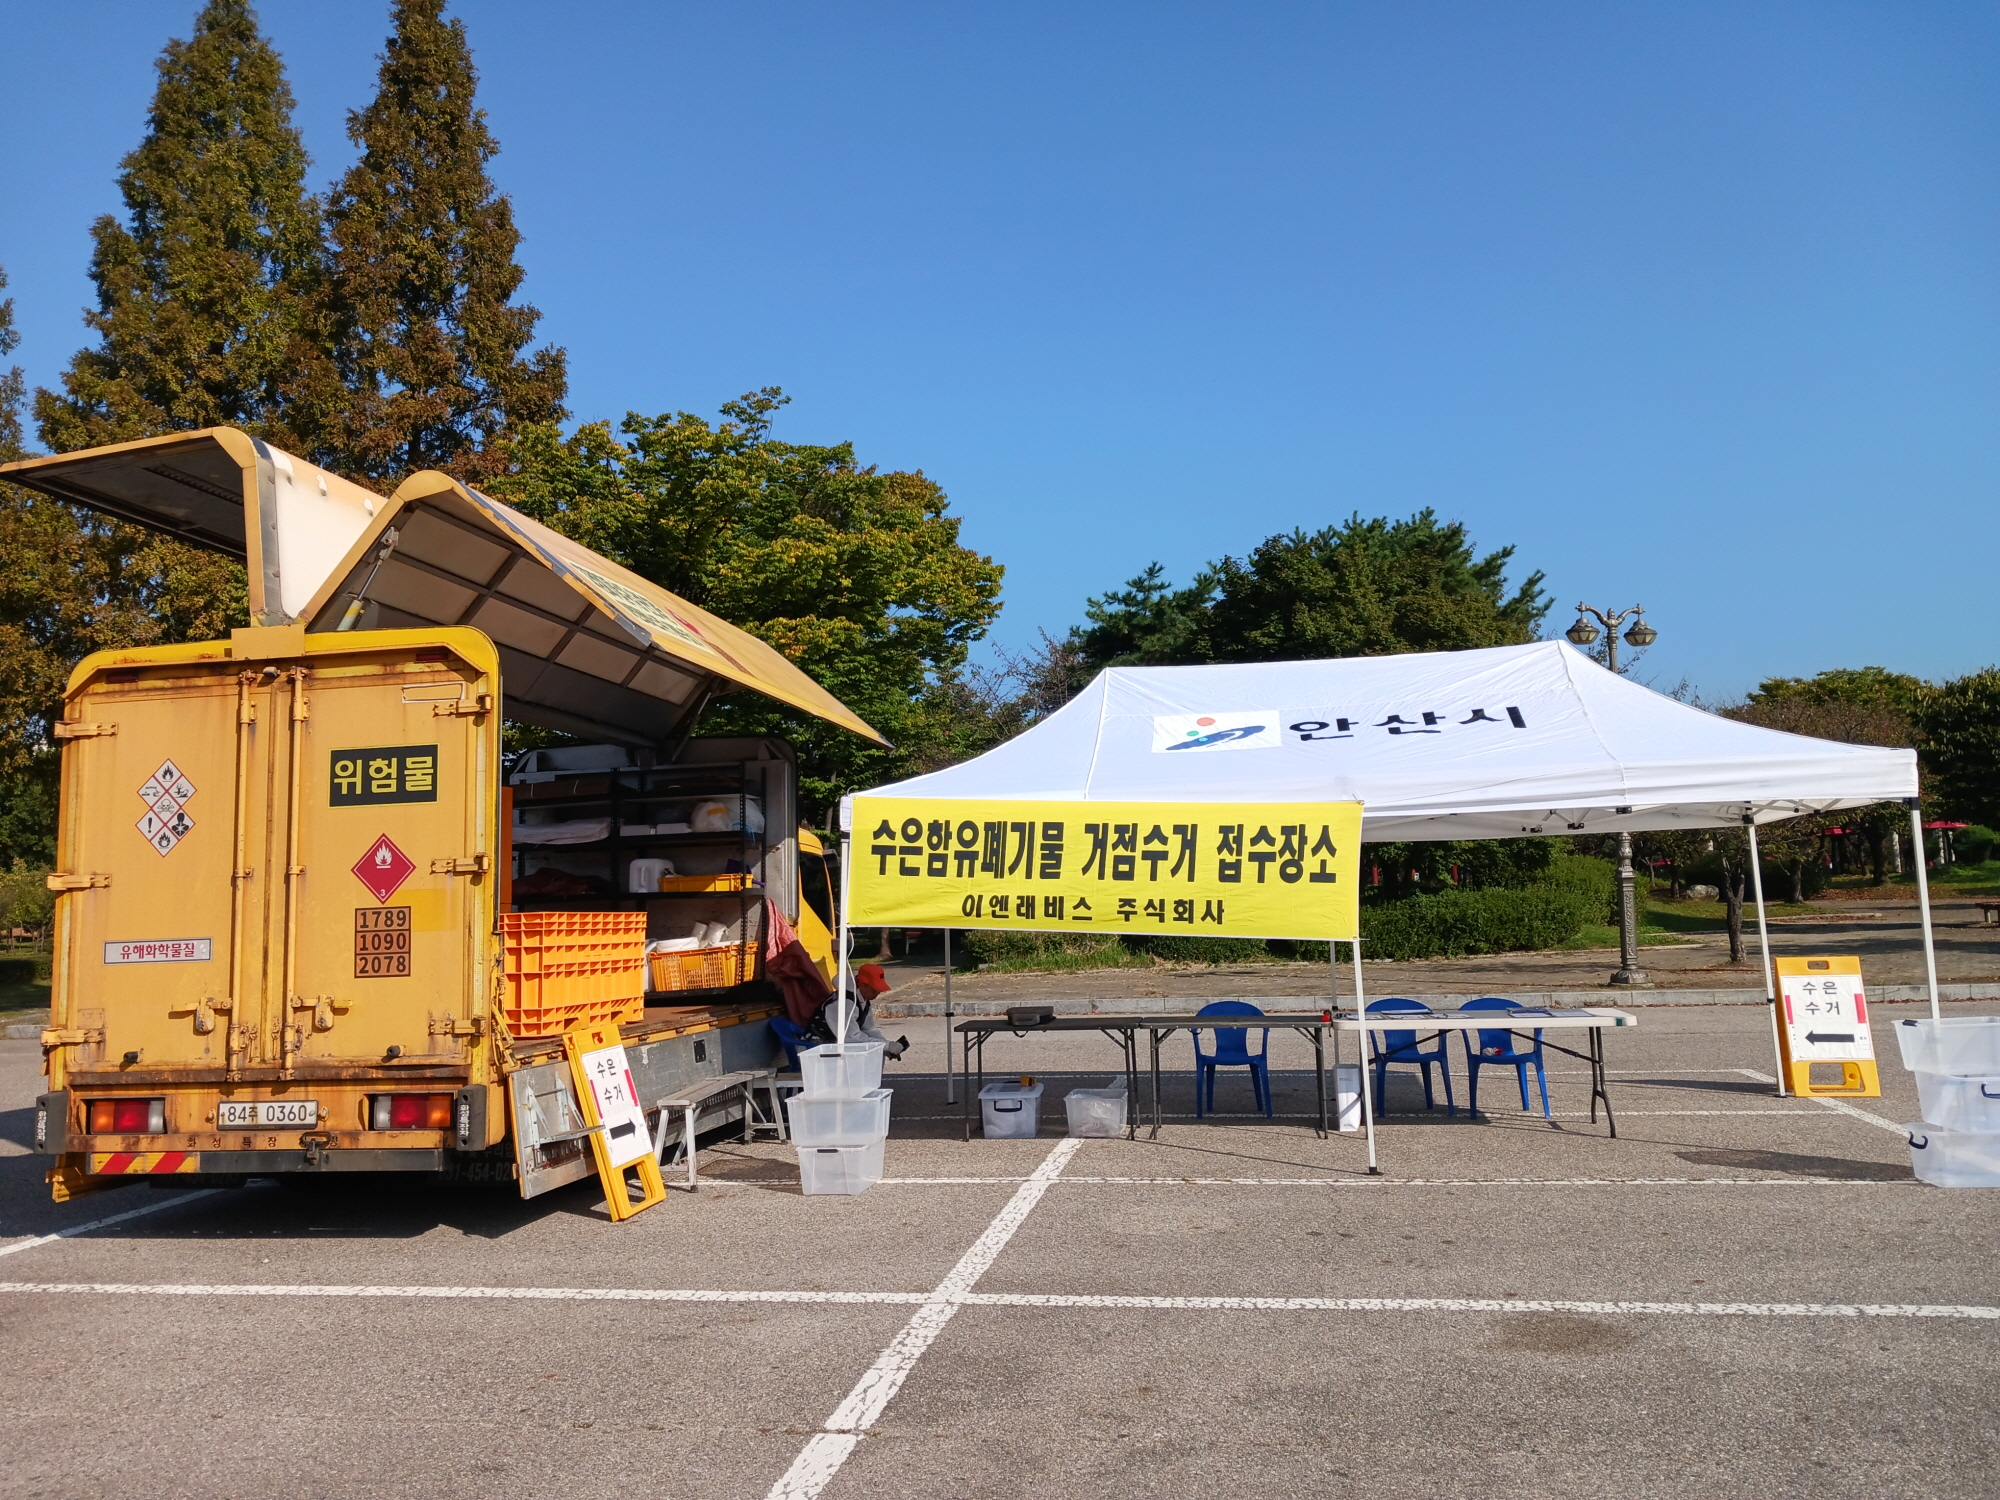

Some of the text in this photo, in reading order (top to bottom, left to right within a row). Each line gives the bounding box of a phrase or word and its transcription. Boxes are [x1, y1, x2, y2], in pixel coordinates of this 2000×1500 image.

[1289, 706, 1528, 741] 안산시
[333, 756, 434, 795] 위험물
[871, 817, 1338, 884] 수은함유폐기물 거점수거 접수장소
[380, 888, 386, 897] 3
[359, 909, 407, 929] 1789
[961, 894, 1225, 925] 이엔래비스 주식회사
[120, 942, 195, 960] 유해화학물질
[359, 932, 407, 952] 1090
[358, 955, 407, 974] 2078
[1802, 981, 1838, 996] 수은
[1805, 1001, 1840, 1016] 수거
[596, 1058, 617, 1079] 수은
[604, 1083, 625, 1106] 수거
[266, 1104, 307, 1122] 0360
